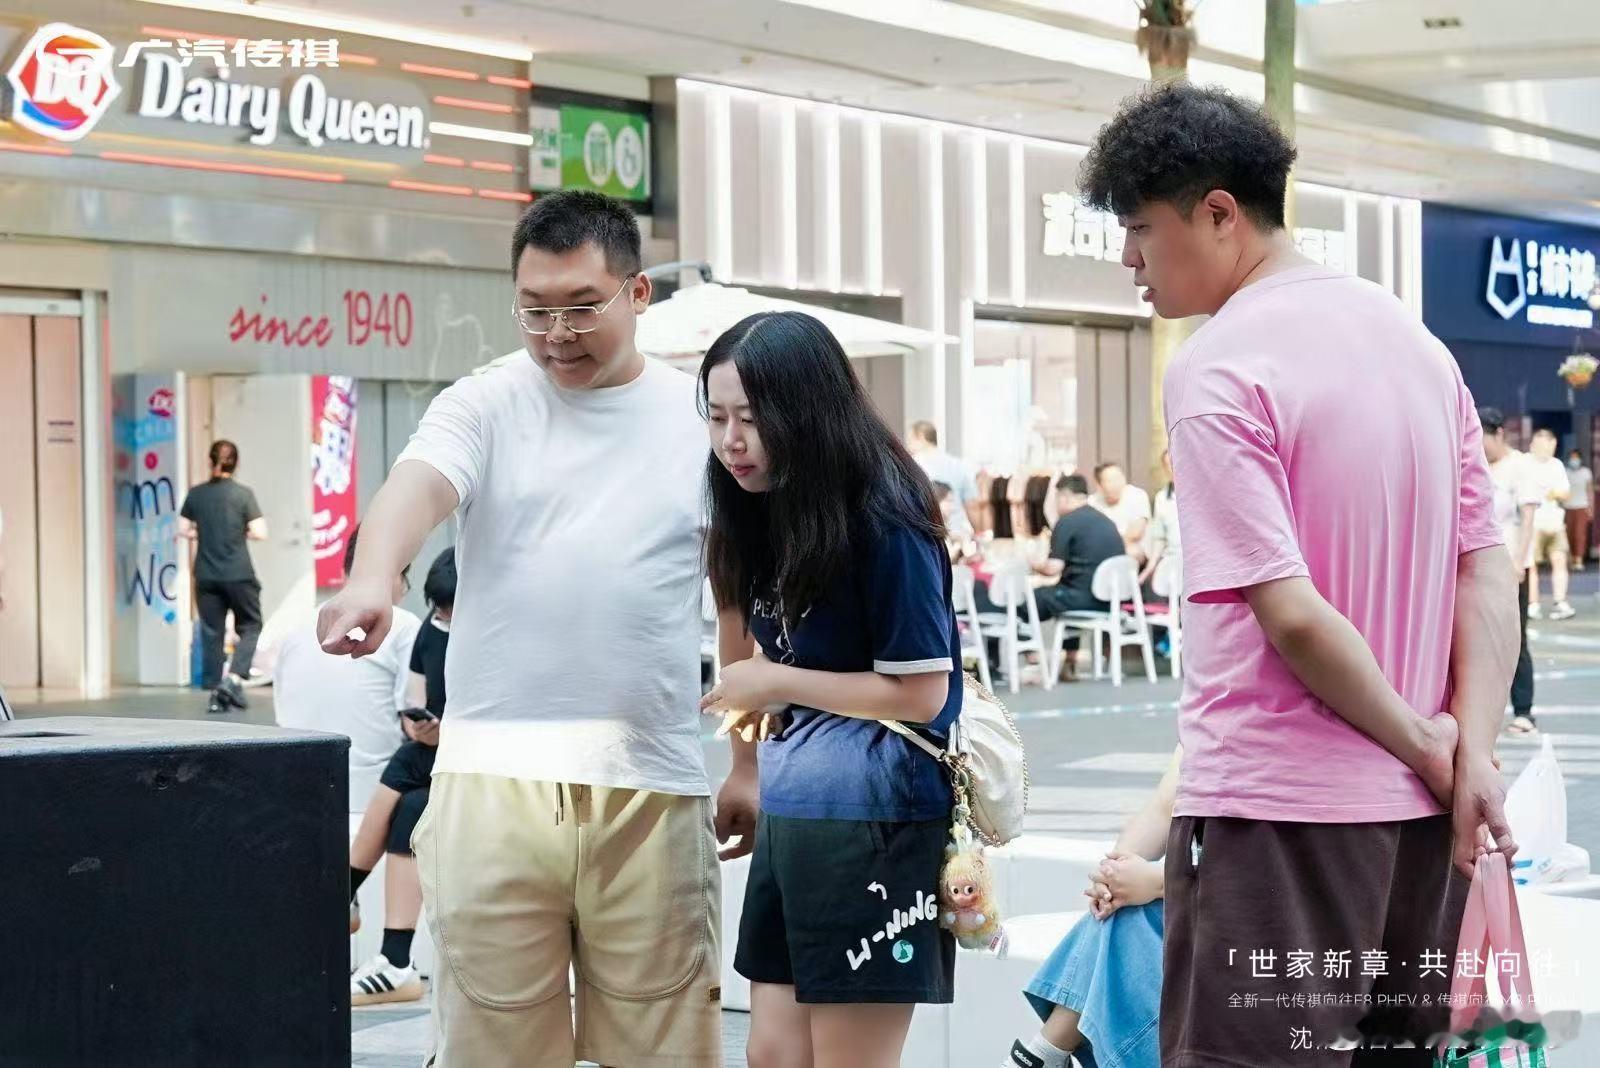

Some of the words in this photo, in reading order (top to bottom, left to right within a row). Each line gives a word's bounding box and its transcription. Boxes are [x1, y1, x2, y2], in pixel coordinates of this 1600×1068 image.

[140, 51, 281, 145] Dairy
[288, 73, 425, 149] Queen
[229, 293, 334, 349] since
[343, 288, 413, 348] 1940
[846, 889, 938, 971] LI-NING
